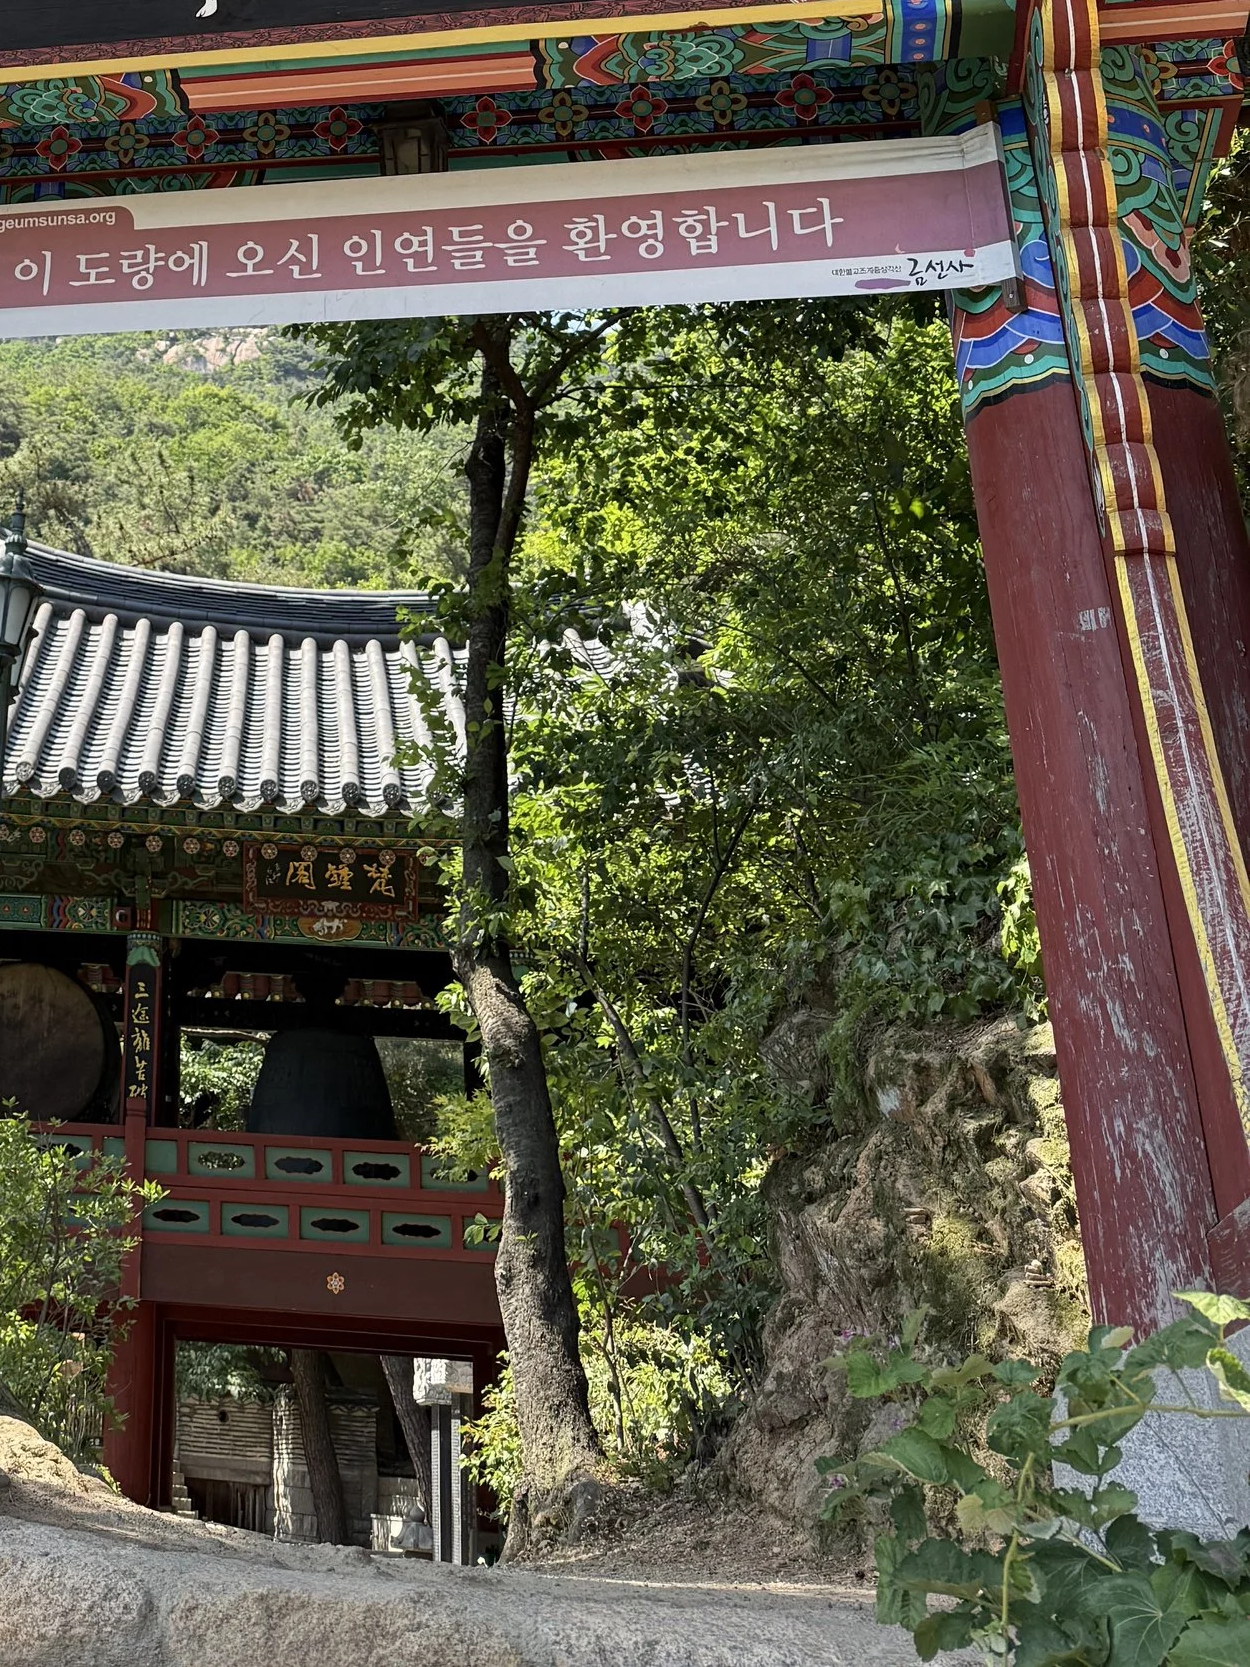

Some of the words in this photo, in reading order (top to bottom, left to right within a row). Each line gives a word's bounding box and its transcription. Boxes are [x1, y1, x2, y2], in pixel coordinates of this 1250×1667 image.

[14, 250, 51, 297] 이
[69, 241, 209, 291] 도량에
[226, 233, 322, 280] 오신
[343, 219, 547, 276] 인연들을
[562, 197, 845, 262] 환영합니다
[906, 257, 975, 287] 금선사
